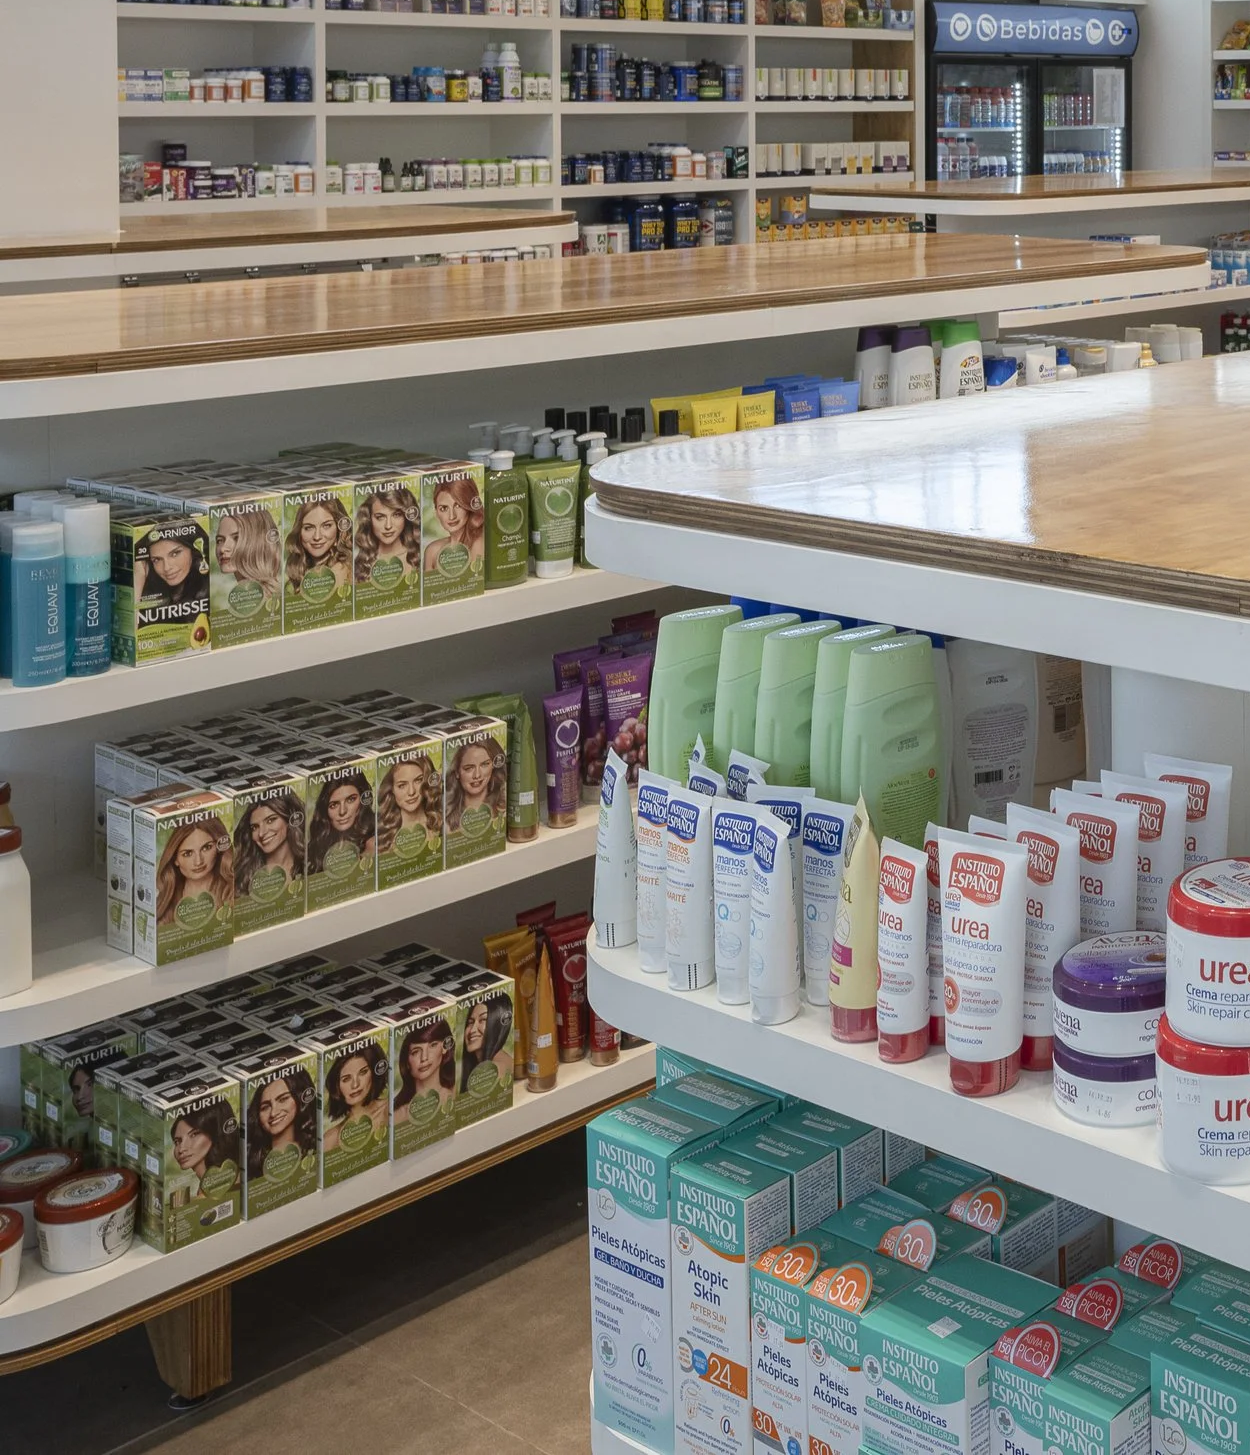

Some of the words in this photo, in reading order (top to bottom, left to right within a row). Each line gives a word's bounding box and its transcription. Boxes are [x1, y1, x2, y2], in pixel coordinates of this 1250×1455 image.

[1000, 19, 1082, 40] Bebidas
[355, 477, 419, 495] NATURTINT
[424, 469, 483, 486] NATURTINT
[540, 477, 575, 487] NATURTINT
[285, 489, 351, 505] NATURTINT
[493, 493, 526, 504] NATURTINT
[210, 500, 281, 518] NATURTINT
[151, 526, 196, 540] GARNIER
[48, 583, 57, 634] EQUAVE
[87, 577, 99, 627] EQUAVE
[138, 598, 208, 624] NUTRISSE
[606, 670, 632, 680] DESERT
[607, 675, 637, 686] ESSENCE
[446, 727, 506, 750] NATURTINT
[378, 745, 443, 768] NATURTINT
[156, 806, 233, 832] NATURTINT
[718, 817, 752, 832] INSTITUTO
[806, 818, 840, 833] INSTITUTO
[715, 829, 752, 847] ESPAÑOL
[804, 828, 840, 847] ESPAÑOL
[715, 865, 748, 877] PERFECTAS
[717, 855, 746, 867] manos
[805, 855, 834, 867] manos
[956, 856, 1000, 877] INSTITUTO
[950, 870, 1000, 897] ESPAÑOL
[952, 916, 990, 940] urea
[961, 938, 1002, 954] reparadora
[978, 963, 996, 974] seca
[456, 985, 513, 1012] NATURTINT
[962, 989, 982, 999] mayor
[962, 996, 991, 1006] porcentaje
[1186, 983, 1218, 1001] Crema
[1187, 1000, 1207, 1015] Skin
[1209, 1005, 1241, 1020] repair
[247, 1059, 318, 1089] NATURTINT
[166, 1088, 240, 1120] NATURTINT
[609, 1109, 639, 1126] Pieles
[637, 1119, 684, 1143] Atópicas
[1198, 1127, 1235, 1141] Crema
[598, 1140, 655, 1177] INSTITUTO
[1199, 1143, 1222, 1156] Skin
[596, 1160, 658, 1205] ESPAÑOL
[642, 1202, 655, 1214] 1903
[680, 1182, 735, 1217] INSTITUTO
[677, 1201, 738, 1244] ESPAÑOL
[967, 1199, 992, 1228] 30
[592, 1226, 620, 1249] Pieles
[621, 1240, 666, 1269] Atópicas
[898, 1234, 923, 1264] 30
[597, 1250, 609, 1263] GEL
[610, 1256, 630, 1273] BAÑO
[630, 1265, 636, 1274] Y
[636, 1268, 662, 1286] DUCHA
[688, 1260, 729, 1290] Atopic
[774, 1253, 804, 1279] 30
[1144, 1257, 1174, 1282] PICOR
[694, 1283, 721, 1306] Skin
[829, 1275, 857, 1306] 30
[690, 1302, 712, 1318] AFTER
[712, 1312, 727, 1325] SUN
[1079, 1298, 1111, 1323] PICOR
[1024, 1333, 1044, 1347] ALIVIA
[1044, 1339, 1051, 1350] EL
[1171, 1337, 1206, 1364] Pieles
[763, 1346, 791, 1369] Pieles
[882, 1339, 939, 1375] INSTITUTO
[1016, 1342, 1049, 1370] PICOR
[710, 1358, 731, 1389] 24
[758, 1359, 799, 1388] Atópicas
[882, 1357, 939, 1395] ESPAÑOL
[1164, 1369, 1237, 1414] INSTITUTO
[876, 1387, 903, 1410] Pieles
[904, 1402, 947, 1428] Atópicas
[1160, 1390, 1241, 1444] ESPAÑOL
[867, 1397, 887, 1415] CREMA
[888, 1405, 920, 1430] CUIDADO
[921, 1422, 957, 1444] INTEGRAL
